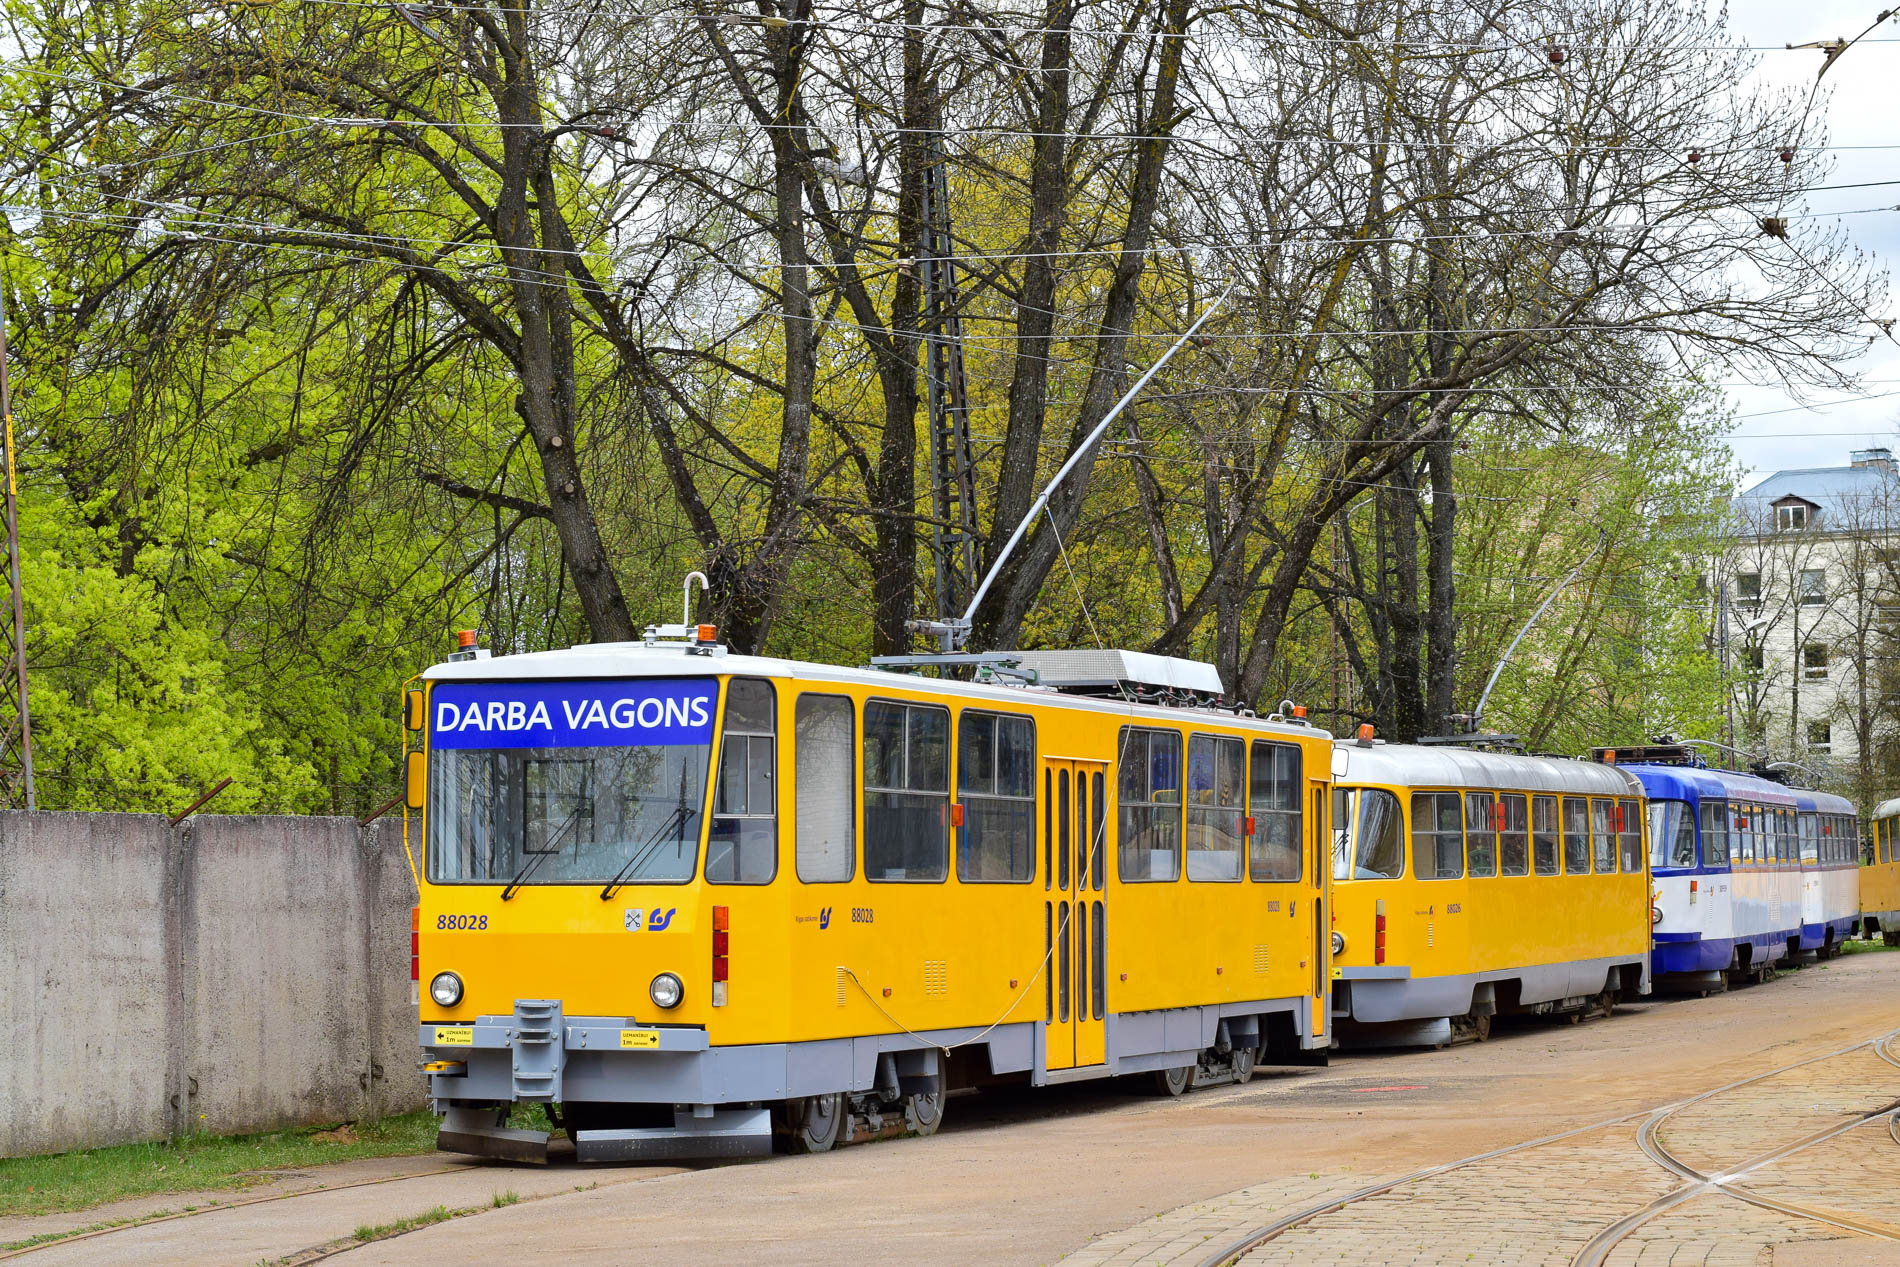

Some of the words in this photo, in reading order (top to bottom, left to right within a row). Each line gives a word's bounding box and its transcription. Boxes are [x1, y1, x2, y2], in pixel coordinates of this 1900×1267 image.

[436, 701, 553, 732] DARBA
[562, 697, 709, 730] VAGONS
[436, 914, 488, 931] 88028
[851, 907, 874, 924] 88028
